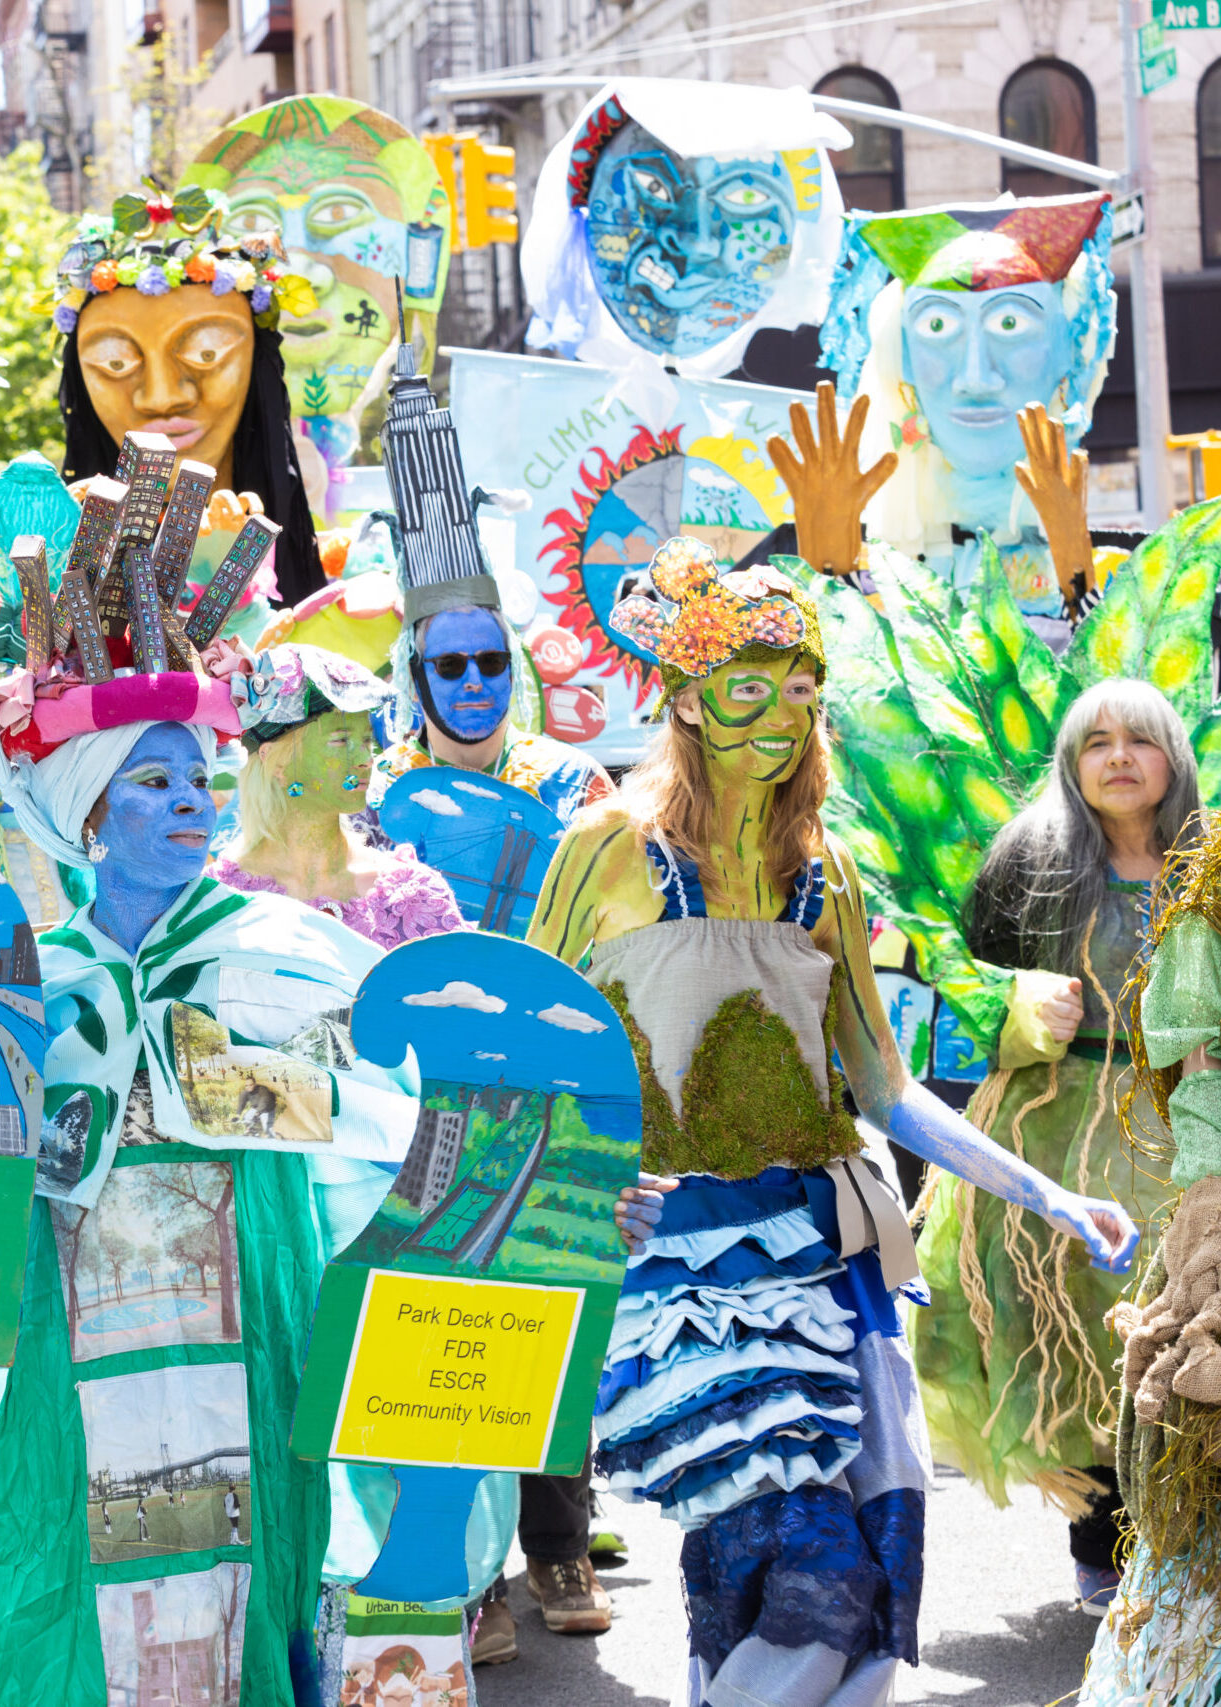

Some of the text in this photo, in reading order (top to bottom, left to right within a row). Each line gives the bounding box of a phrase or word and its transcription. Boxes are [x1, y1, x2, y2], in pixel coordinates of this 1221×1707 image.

[1164, 0, 1220, 27] Ave B
[397, 1303, 545, 1334] Park Deck Over
[443, 1339, 486, 1360] FDR
[429, 1369, 487, 1391] ESCR
[366, 1395, 531, 1426] Community Vision
[366, 1601, 399, 1614] Urban
